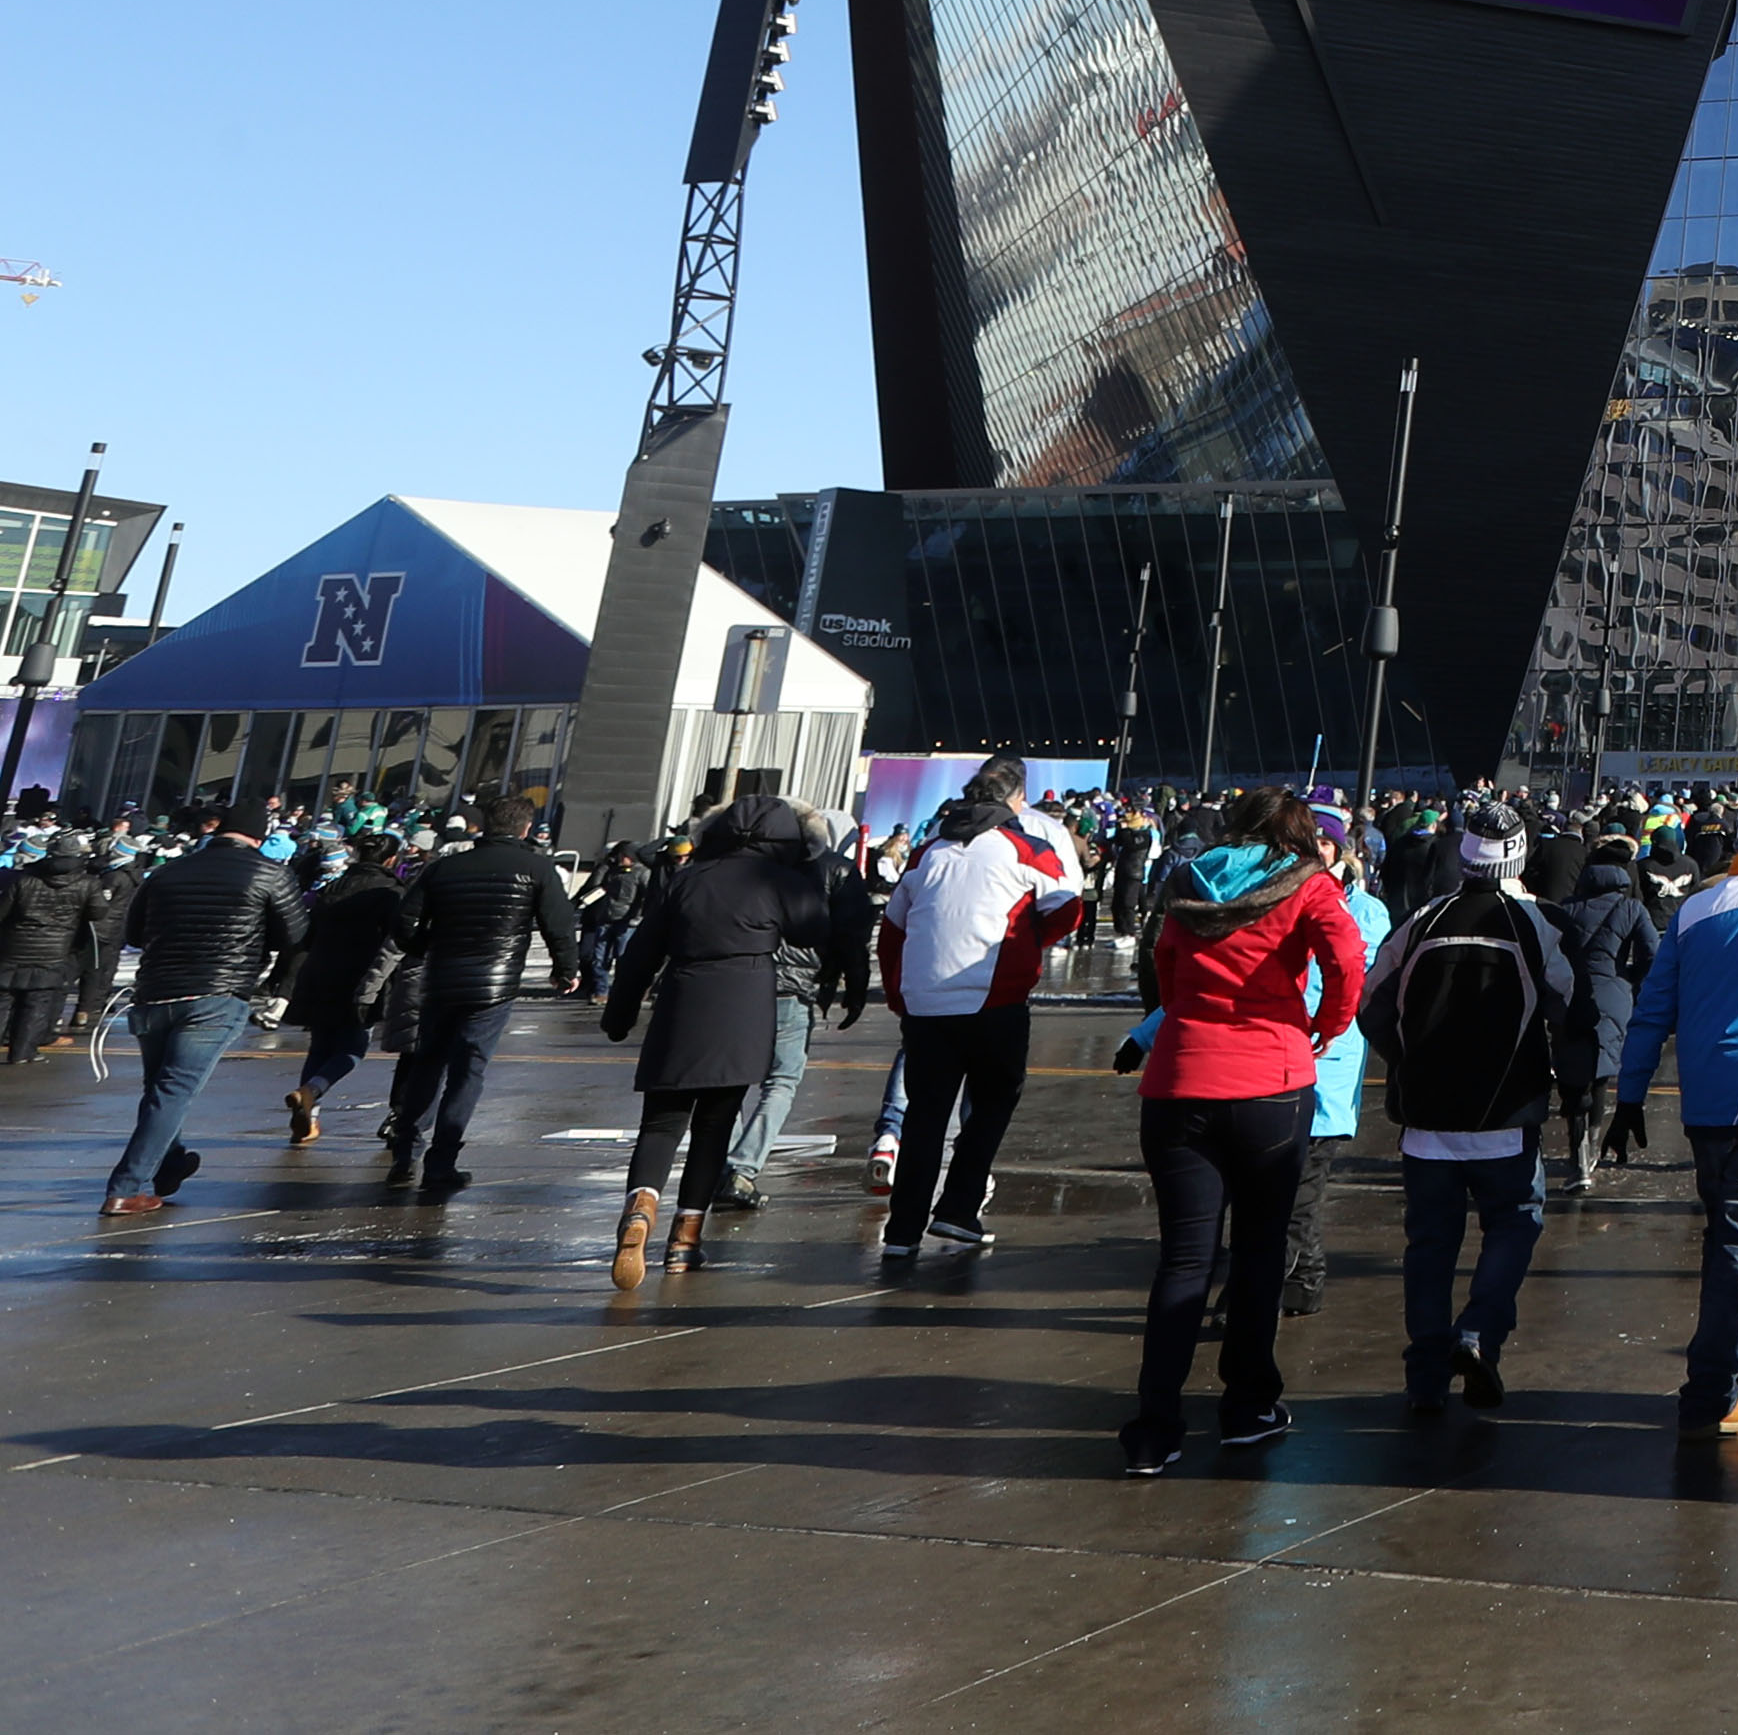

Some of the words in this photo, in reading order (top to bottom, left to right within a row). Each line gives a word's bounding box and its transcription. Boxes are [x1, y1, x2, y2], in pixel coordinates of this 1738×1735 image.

[301, 571, 406, 668] N
[842, 632, 912, 650] stadium
[1638, 756, 1699, 773] LEGACY
